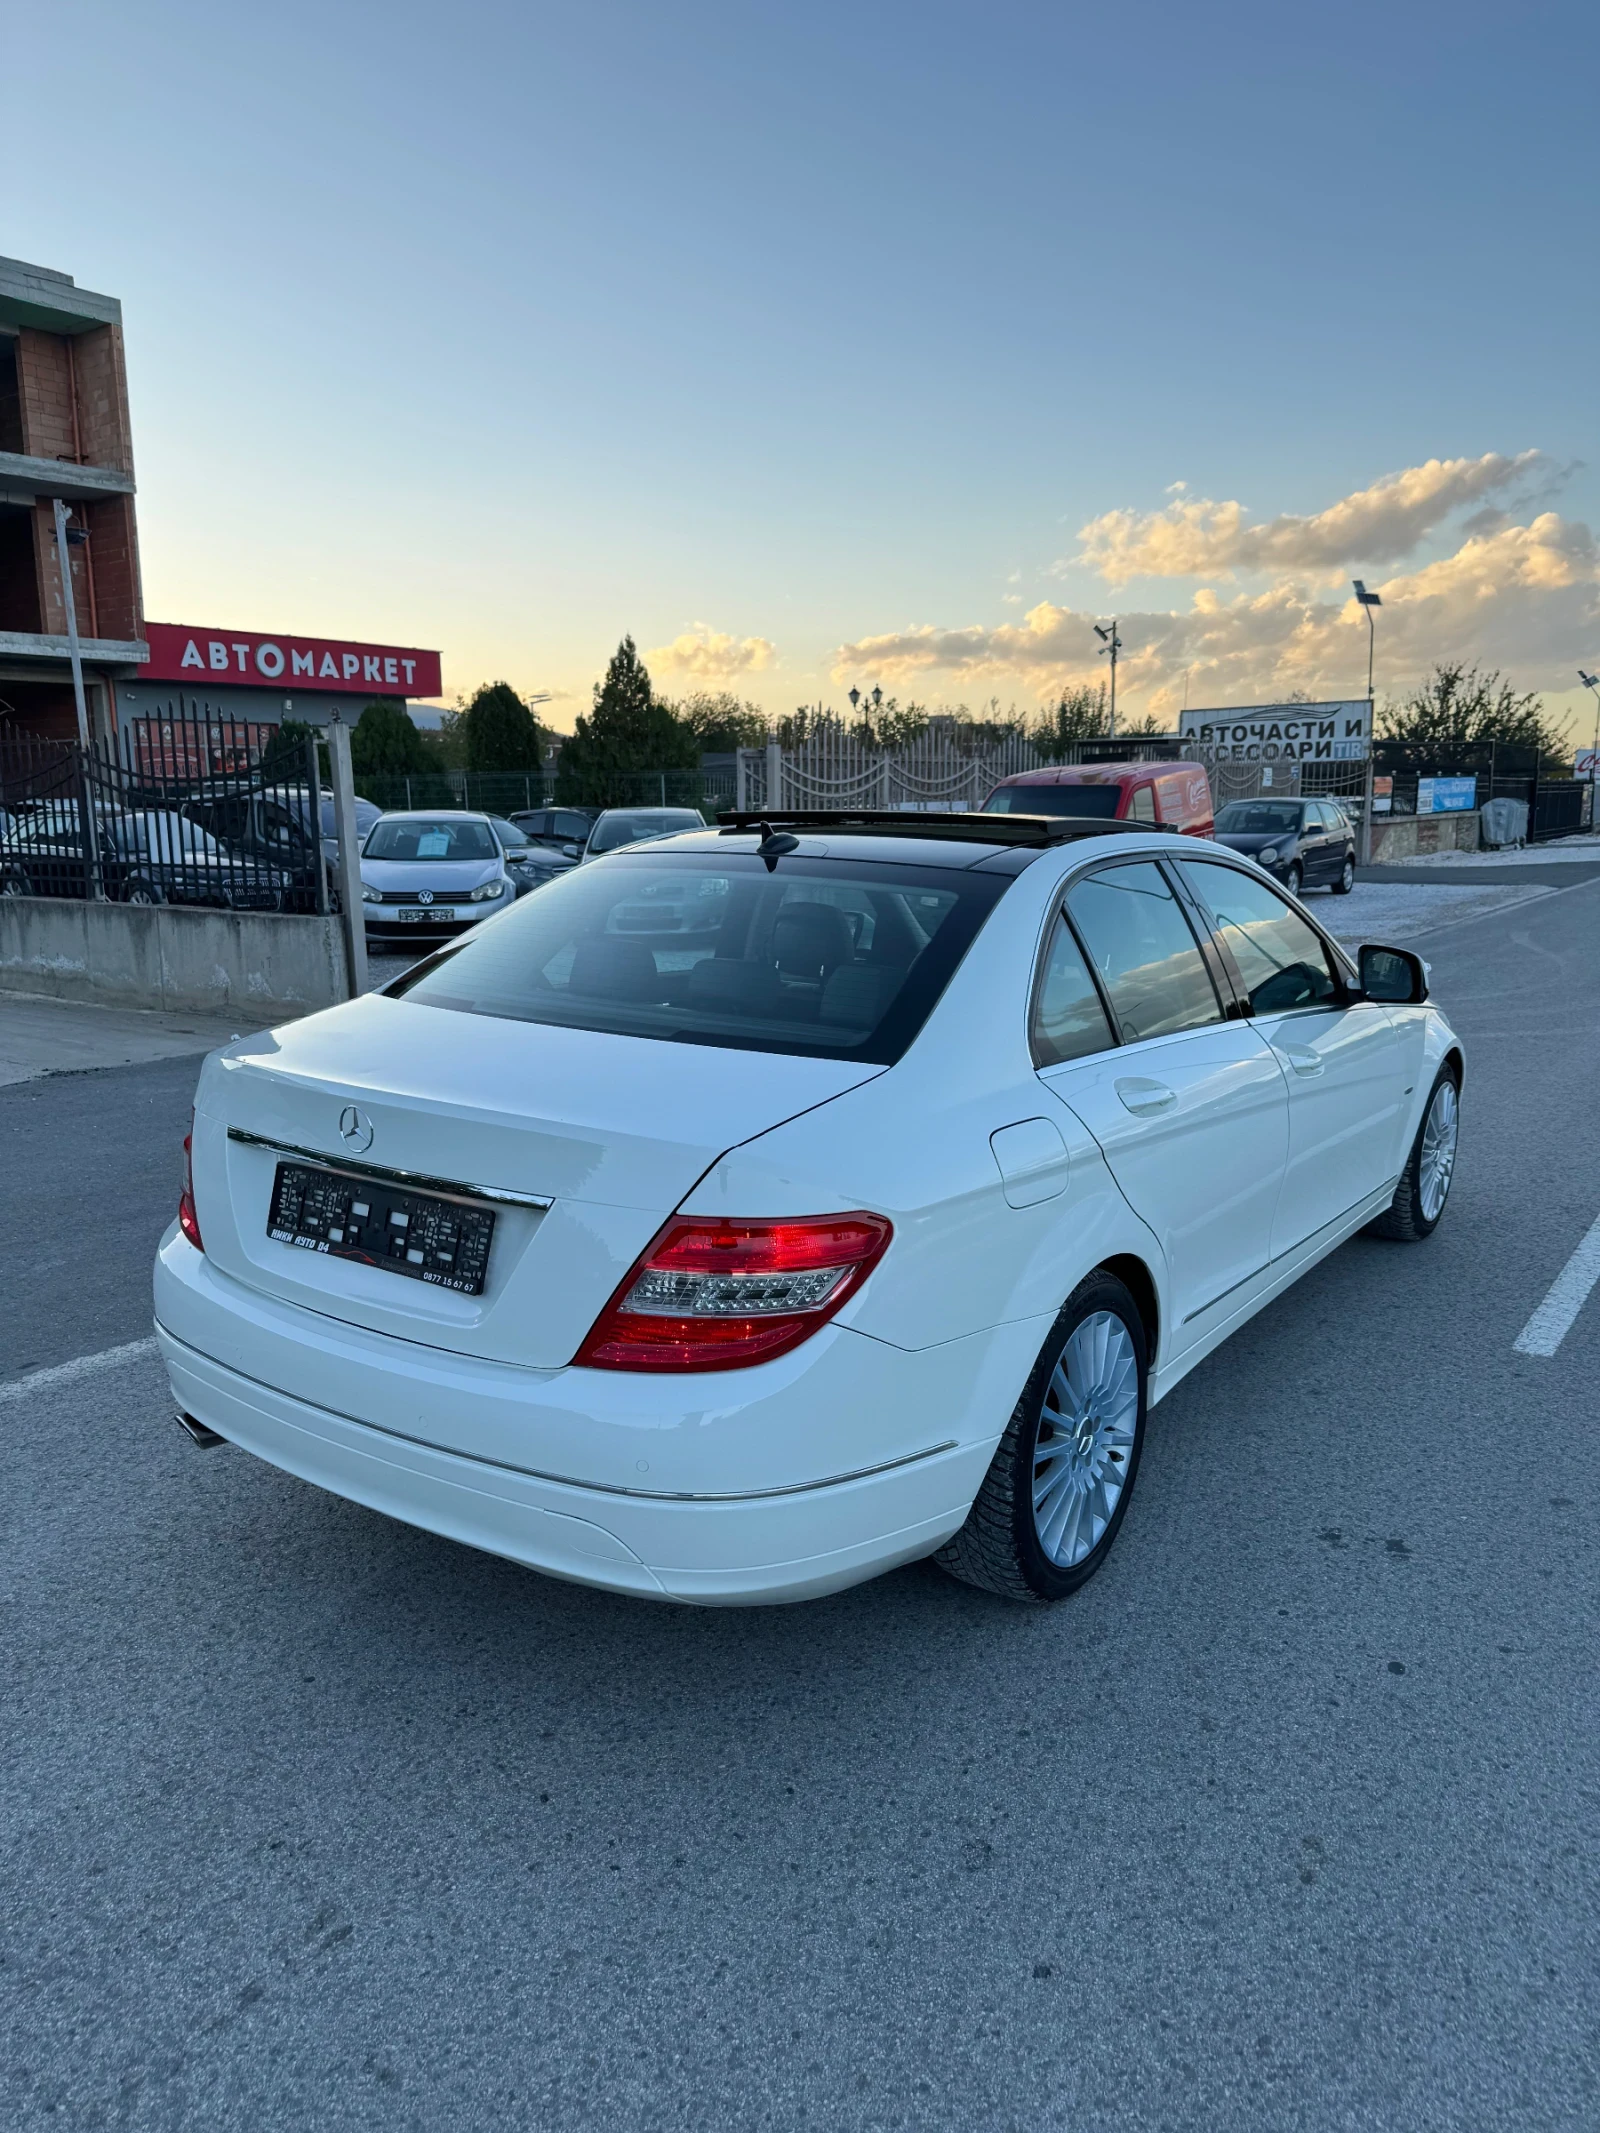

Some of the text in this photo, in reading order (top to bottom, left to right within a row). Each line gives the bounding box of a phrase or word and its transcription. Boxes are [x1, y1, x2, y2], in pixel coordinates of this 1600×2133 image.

[180, 639, 417, 685] АВТОМАРКЕТ
[1185, 719, 1363, 743] АВТОЧАСТИ И
[1335, 742, 1362, 758] TIR
[270, 1228, 294, 1243] НИКИ
[294, 1235, 317, 1249] АУТО
[423, 1271, 474, 1292] 0877 15 67 67
